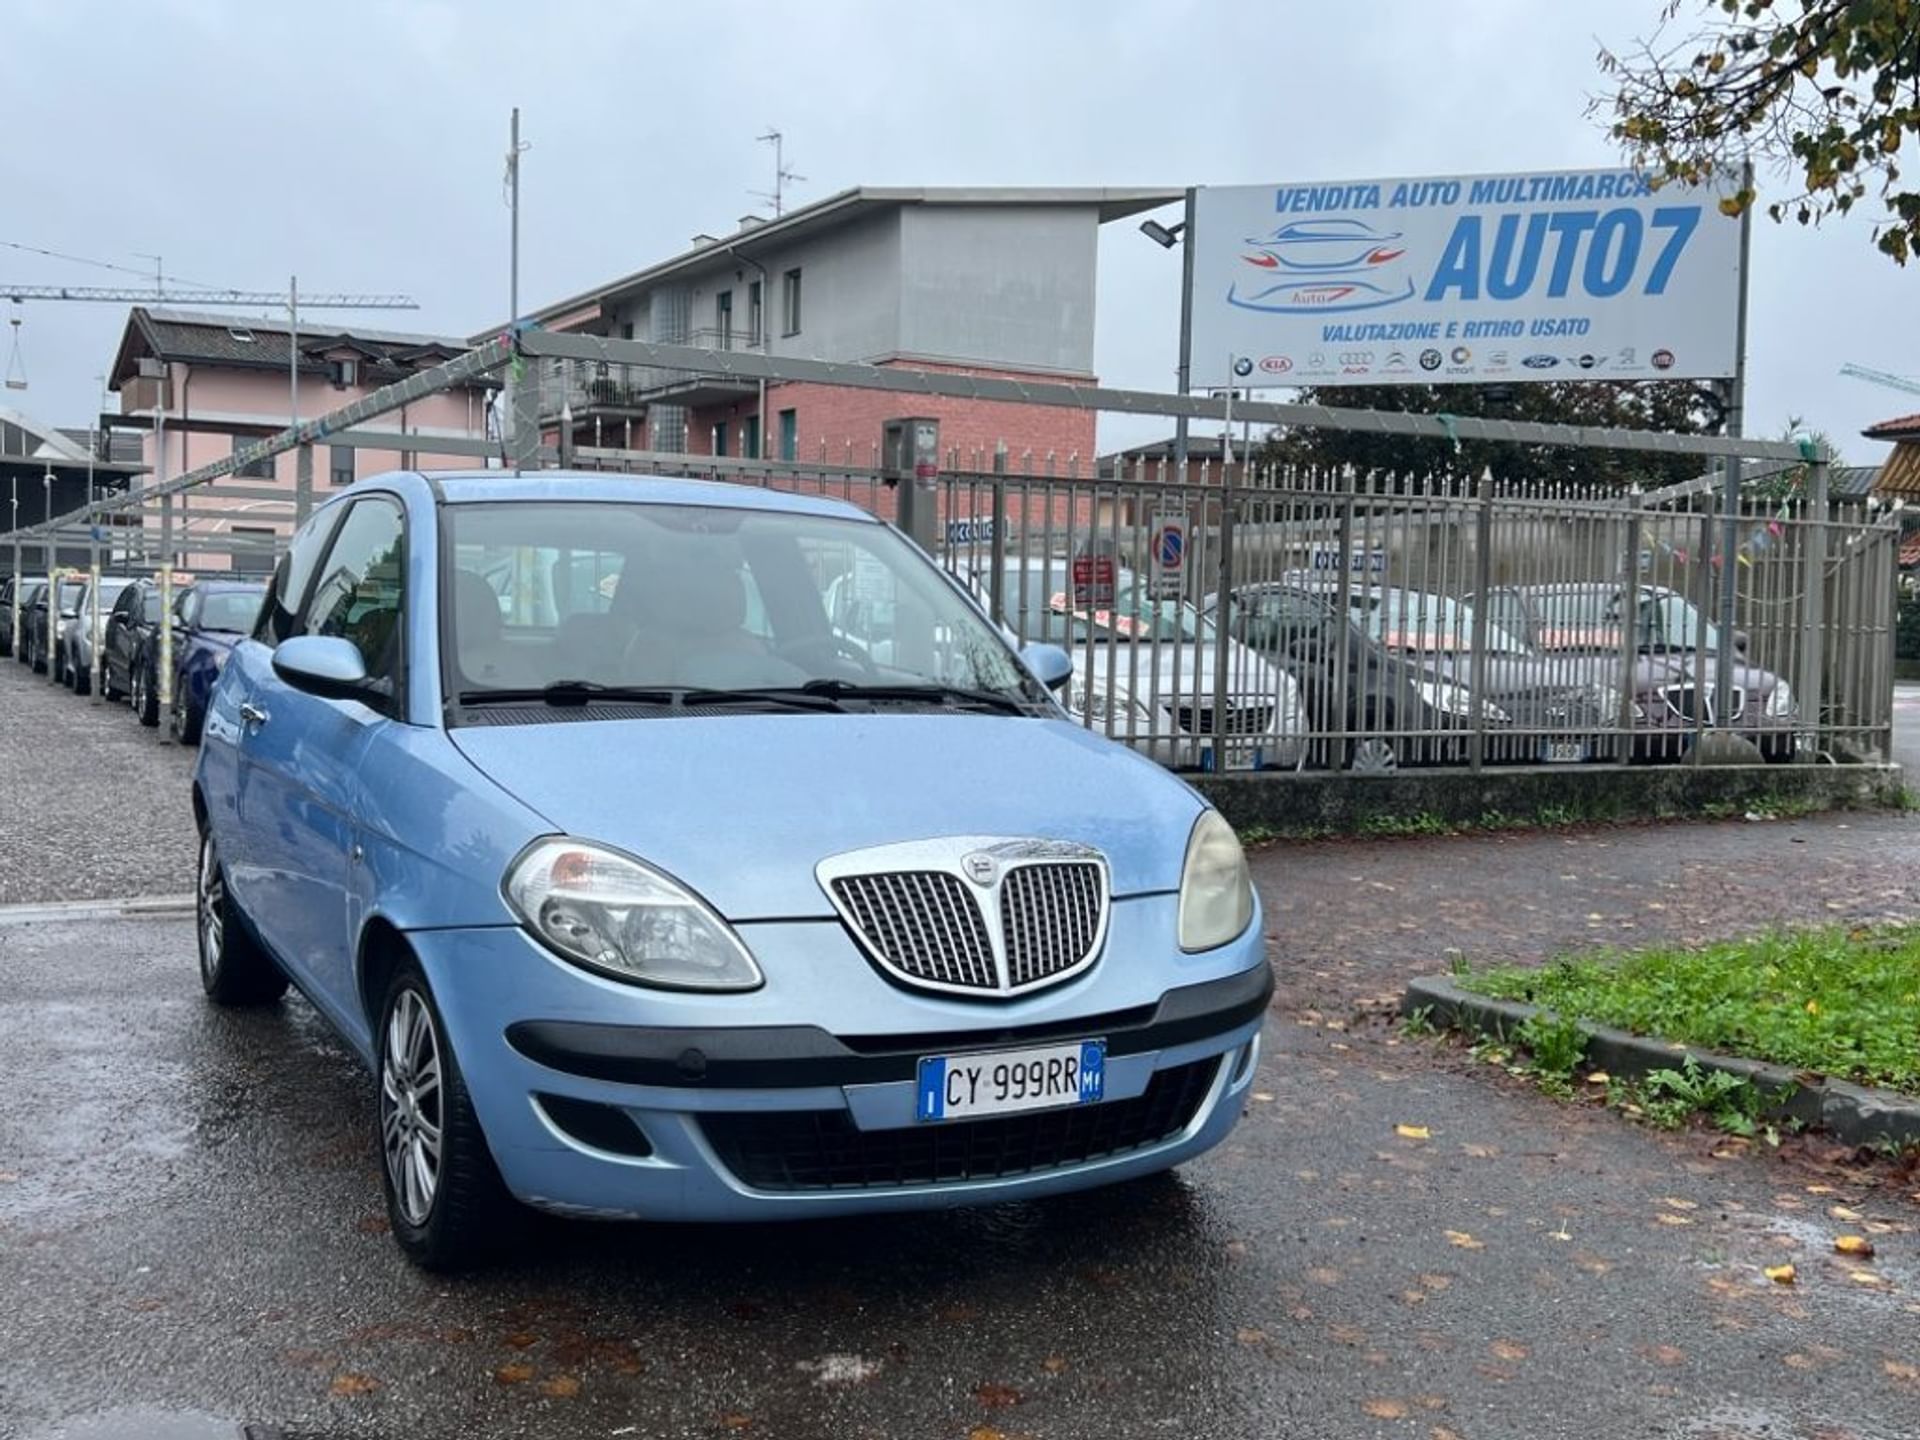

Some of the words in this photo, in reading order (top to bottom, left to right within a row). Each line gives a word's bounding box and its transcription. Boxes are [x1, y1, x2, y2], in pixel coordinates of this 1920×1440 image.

[1276, 184, 1381, 213] VENDITA
[1388, 180, 1460, 208] AUTO
[1469, 172, 1653, 204] MULTIMARCA
[1424, 206, 1701, 301] AUTO7
[1322, 323, 1441, 342] VALUTAZIONE
[1446, 321, 1459, 339] E
[1463, 319, 1525, 339] RITIRO
[1531, 318, 1590, 336] USATO
[946, 1067, 983, 1106] CY
[993, 1056, 1078, 1101] 999RR
